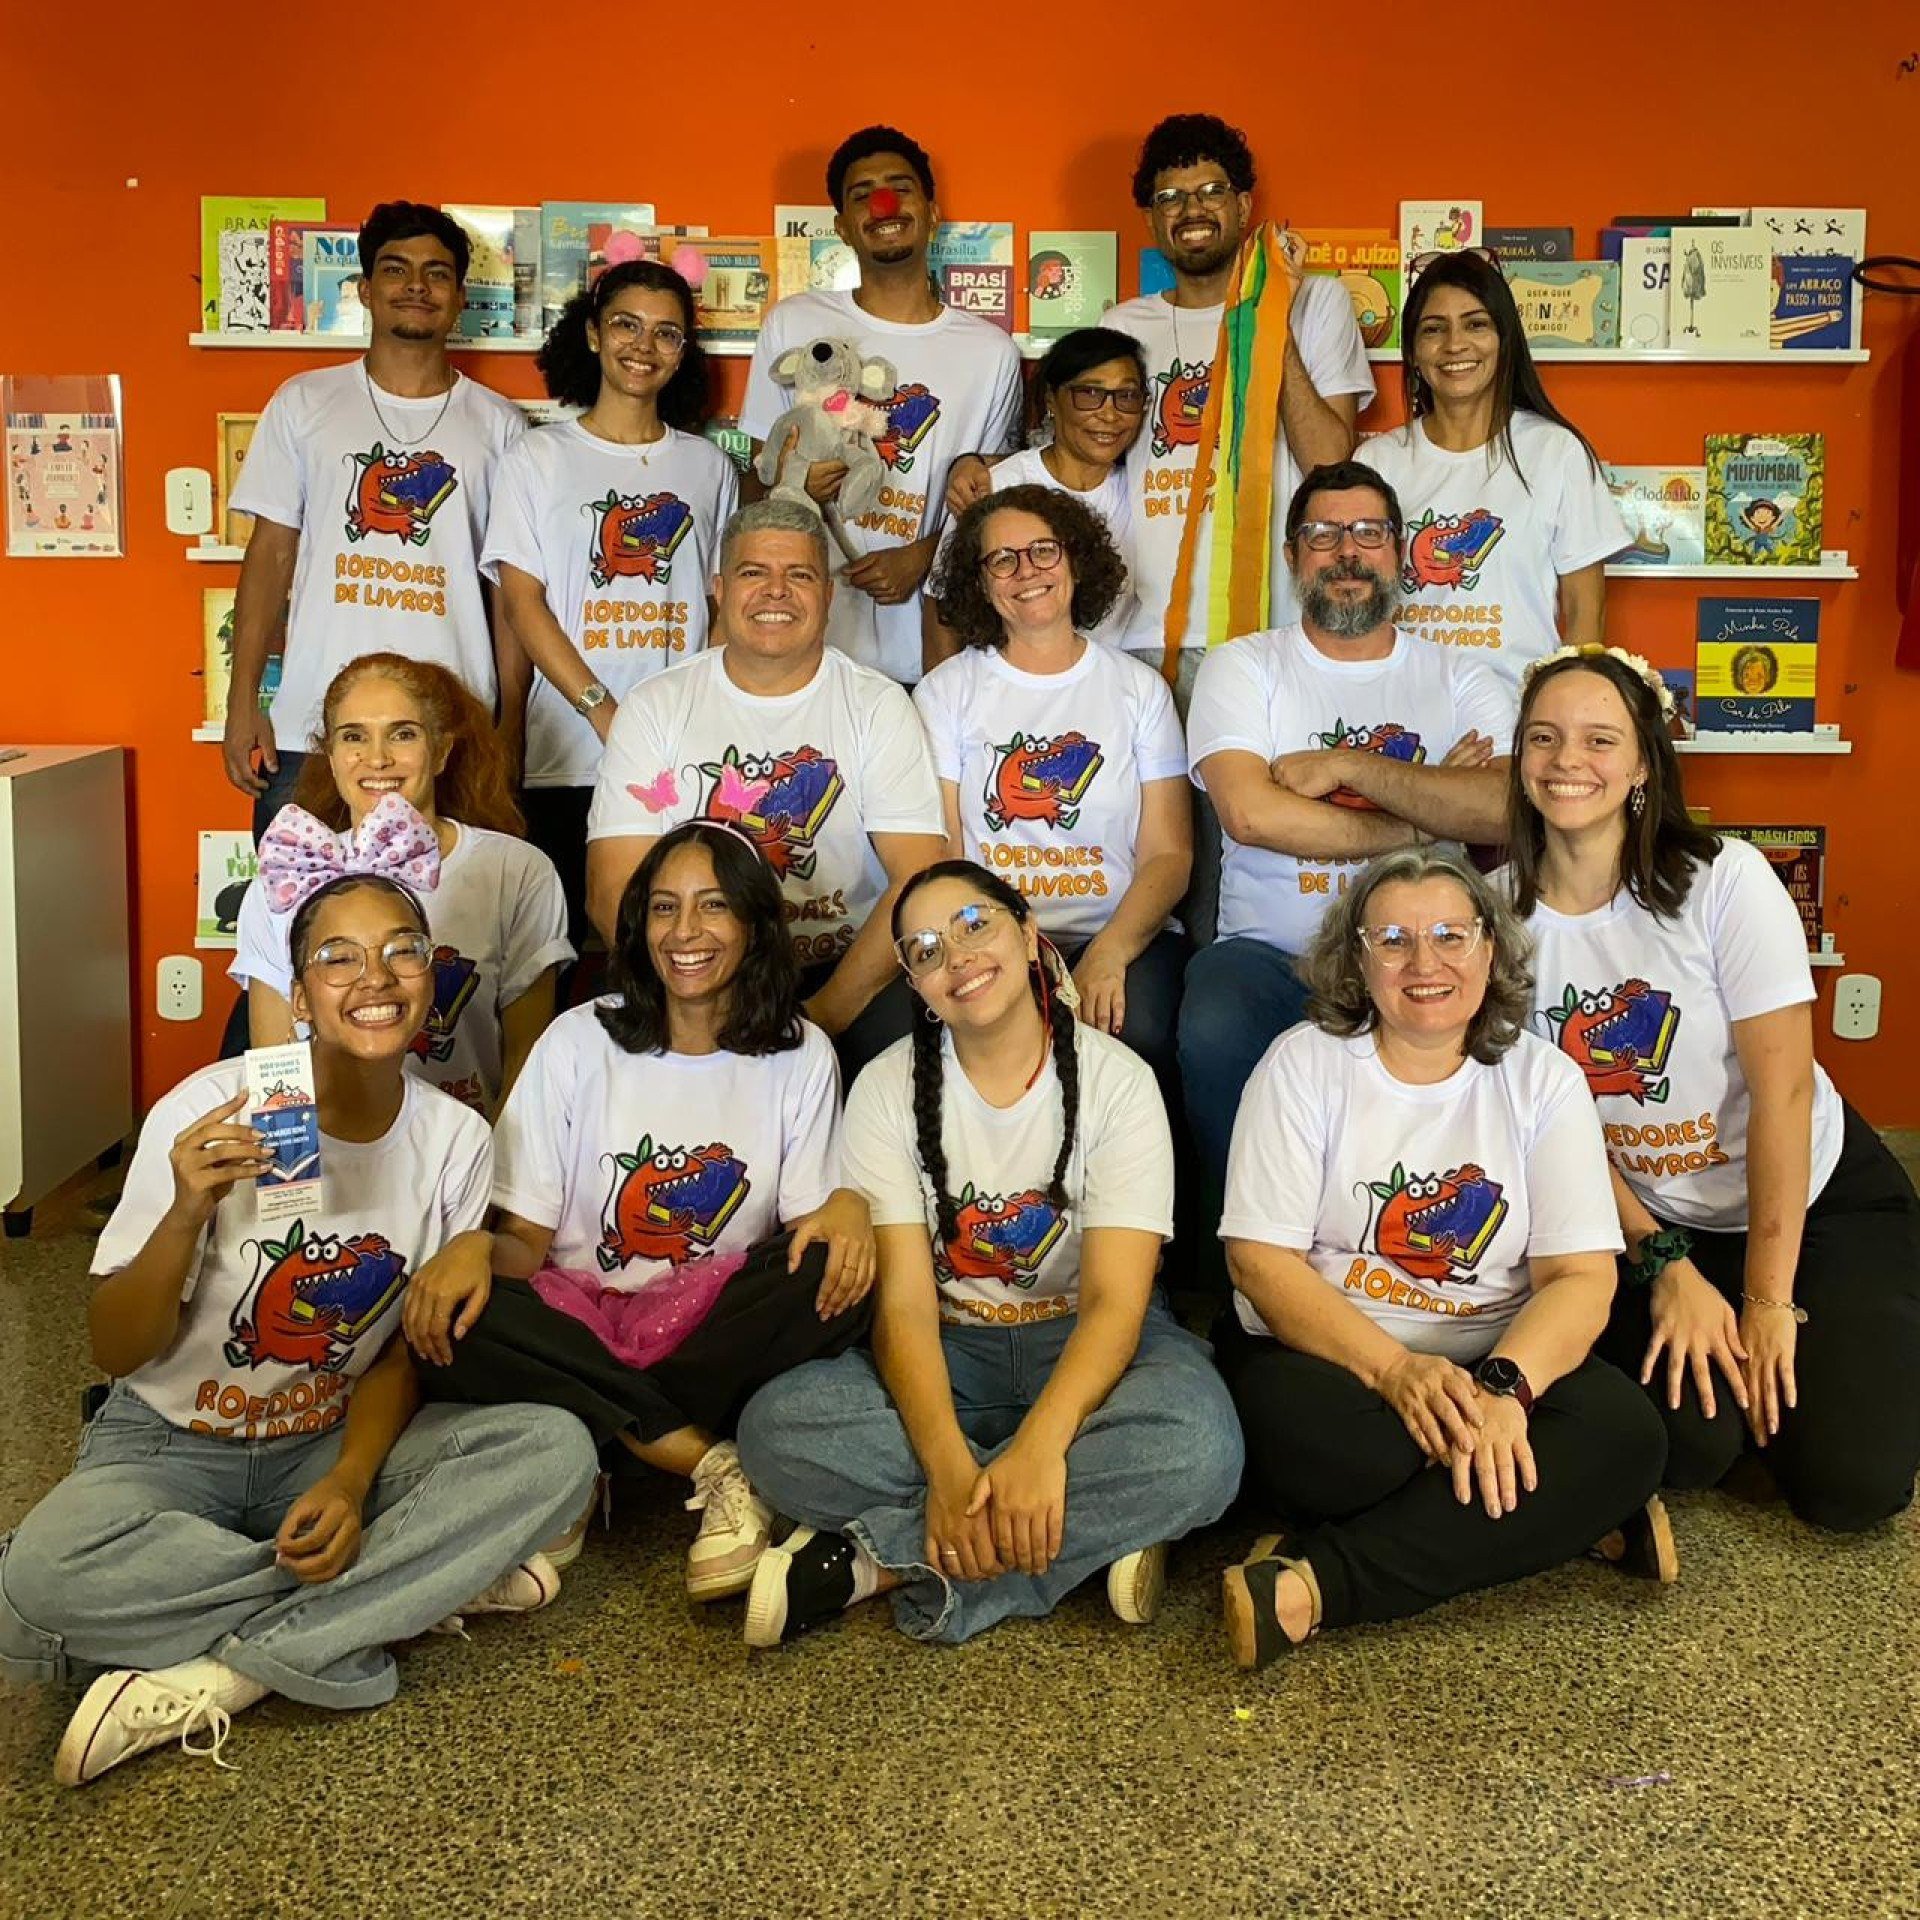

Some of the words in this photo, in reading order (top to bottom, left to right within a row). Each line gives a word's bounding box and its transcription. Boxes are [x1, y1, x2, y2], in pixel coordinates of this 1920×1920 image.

[224, 216, 272, 231] BRAS
[1335, 246, 1347, 263] O
[1351, 243, 1399, 264] JUÍZO
[1711, 241, 1724, 254] OS
[1710, 253, 1764, 270] INVISÍVEIS
[950, 269, 1007, 288] BRASÍ
[1799, 278, 1842, 292] ABRAÇO
[1786, 294, 1810, 307] PASSO
[1818, 293, 1843, 307] PASSO
[1726, 462, 1802, 482] MUFUMBAL
[1633, 485, 1700, 502] Clodoaldo
[335, 552, 446, 589] ROEDORES
[335, 583, 359, 604] DE
[363, 584, 446, 616] LIVROS
[583, 628, 609, 650] DE
[1298, 871, 1330, 895] DE
[1604, 1112, 1717, 1149] EDORES
